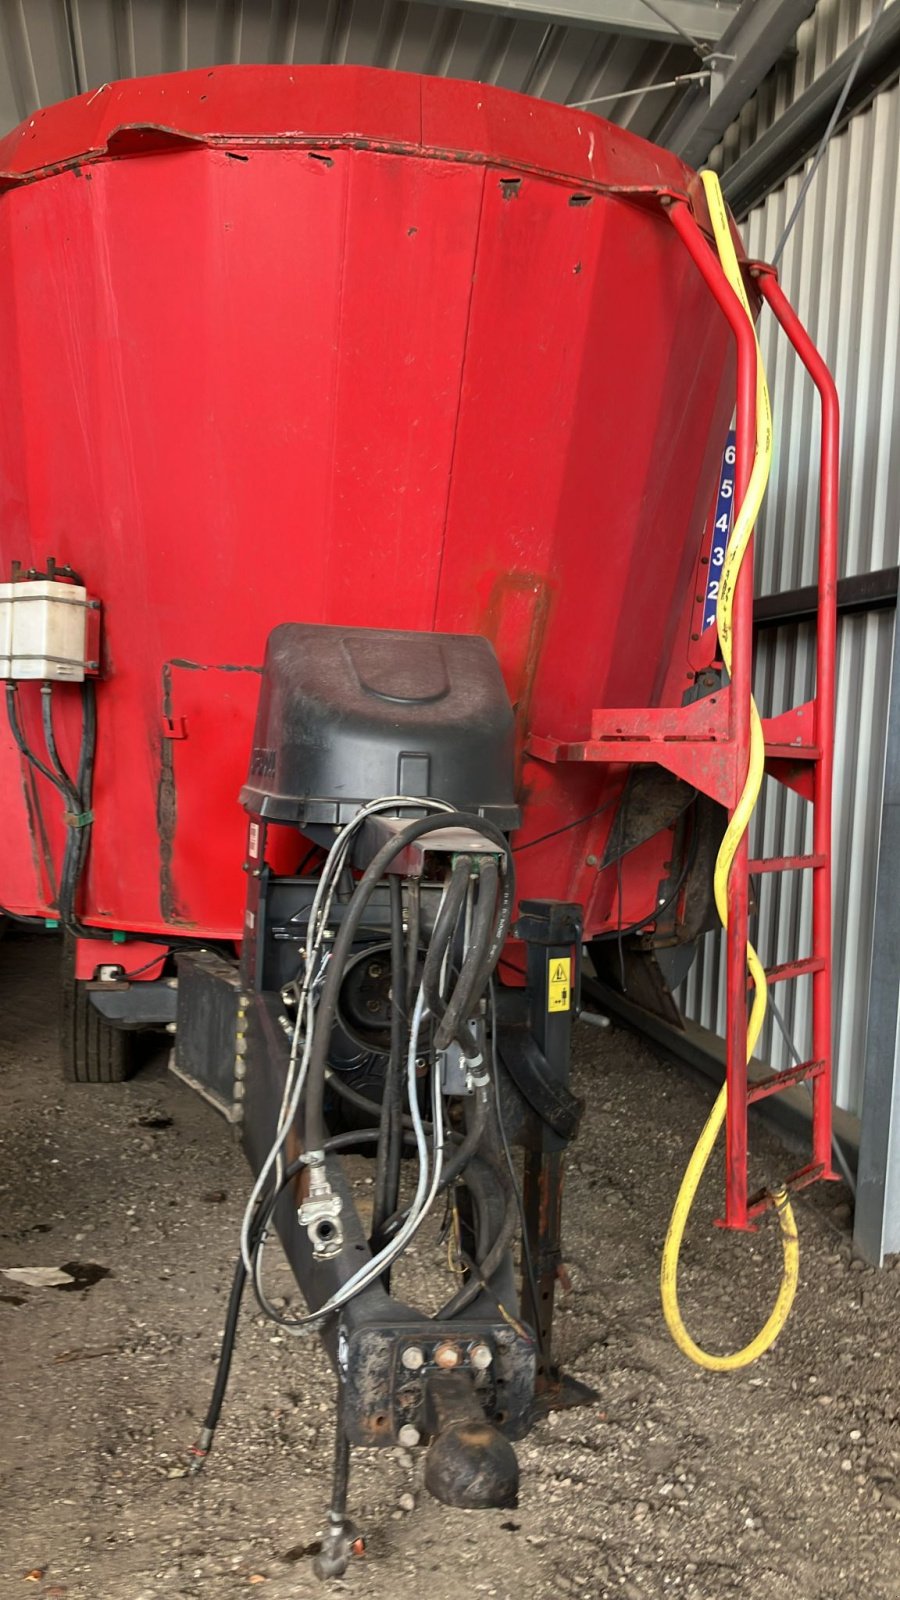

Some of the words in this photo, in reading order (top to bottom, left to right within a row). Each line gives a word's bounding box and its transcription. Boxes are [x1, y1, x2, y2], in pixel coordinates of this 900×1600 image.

[725, 446, 736, 465] 6
[720, 479, 733, 498] 5
[716, 513, 728, 532] 4
[712, 547, 724, 566] 3
[707, 581, 719, 599] 2
